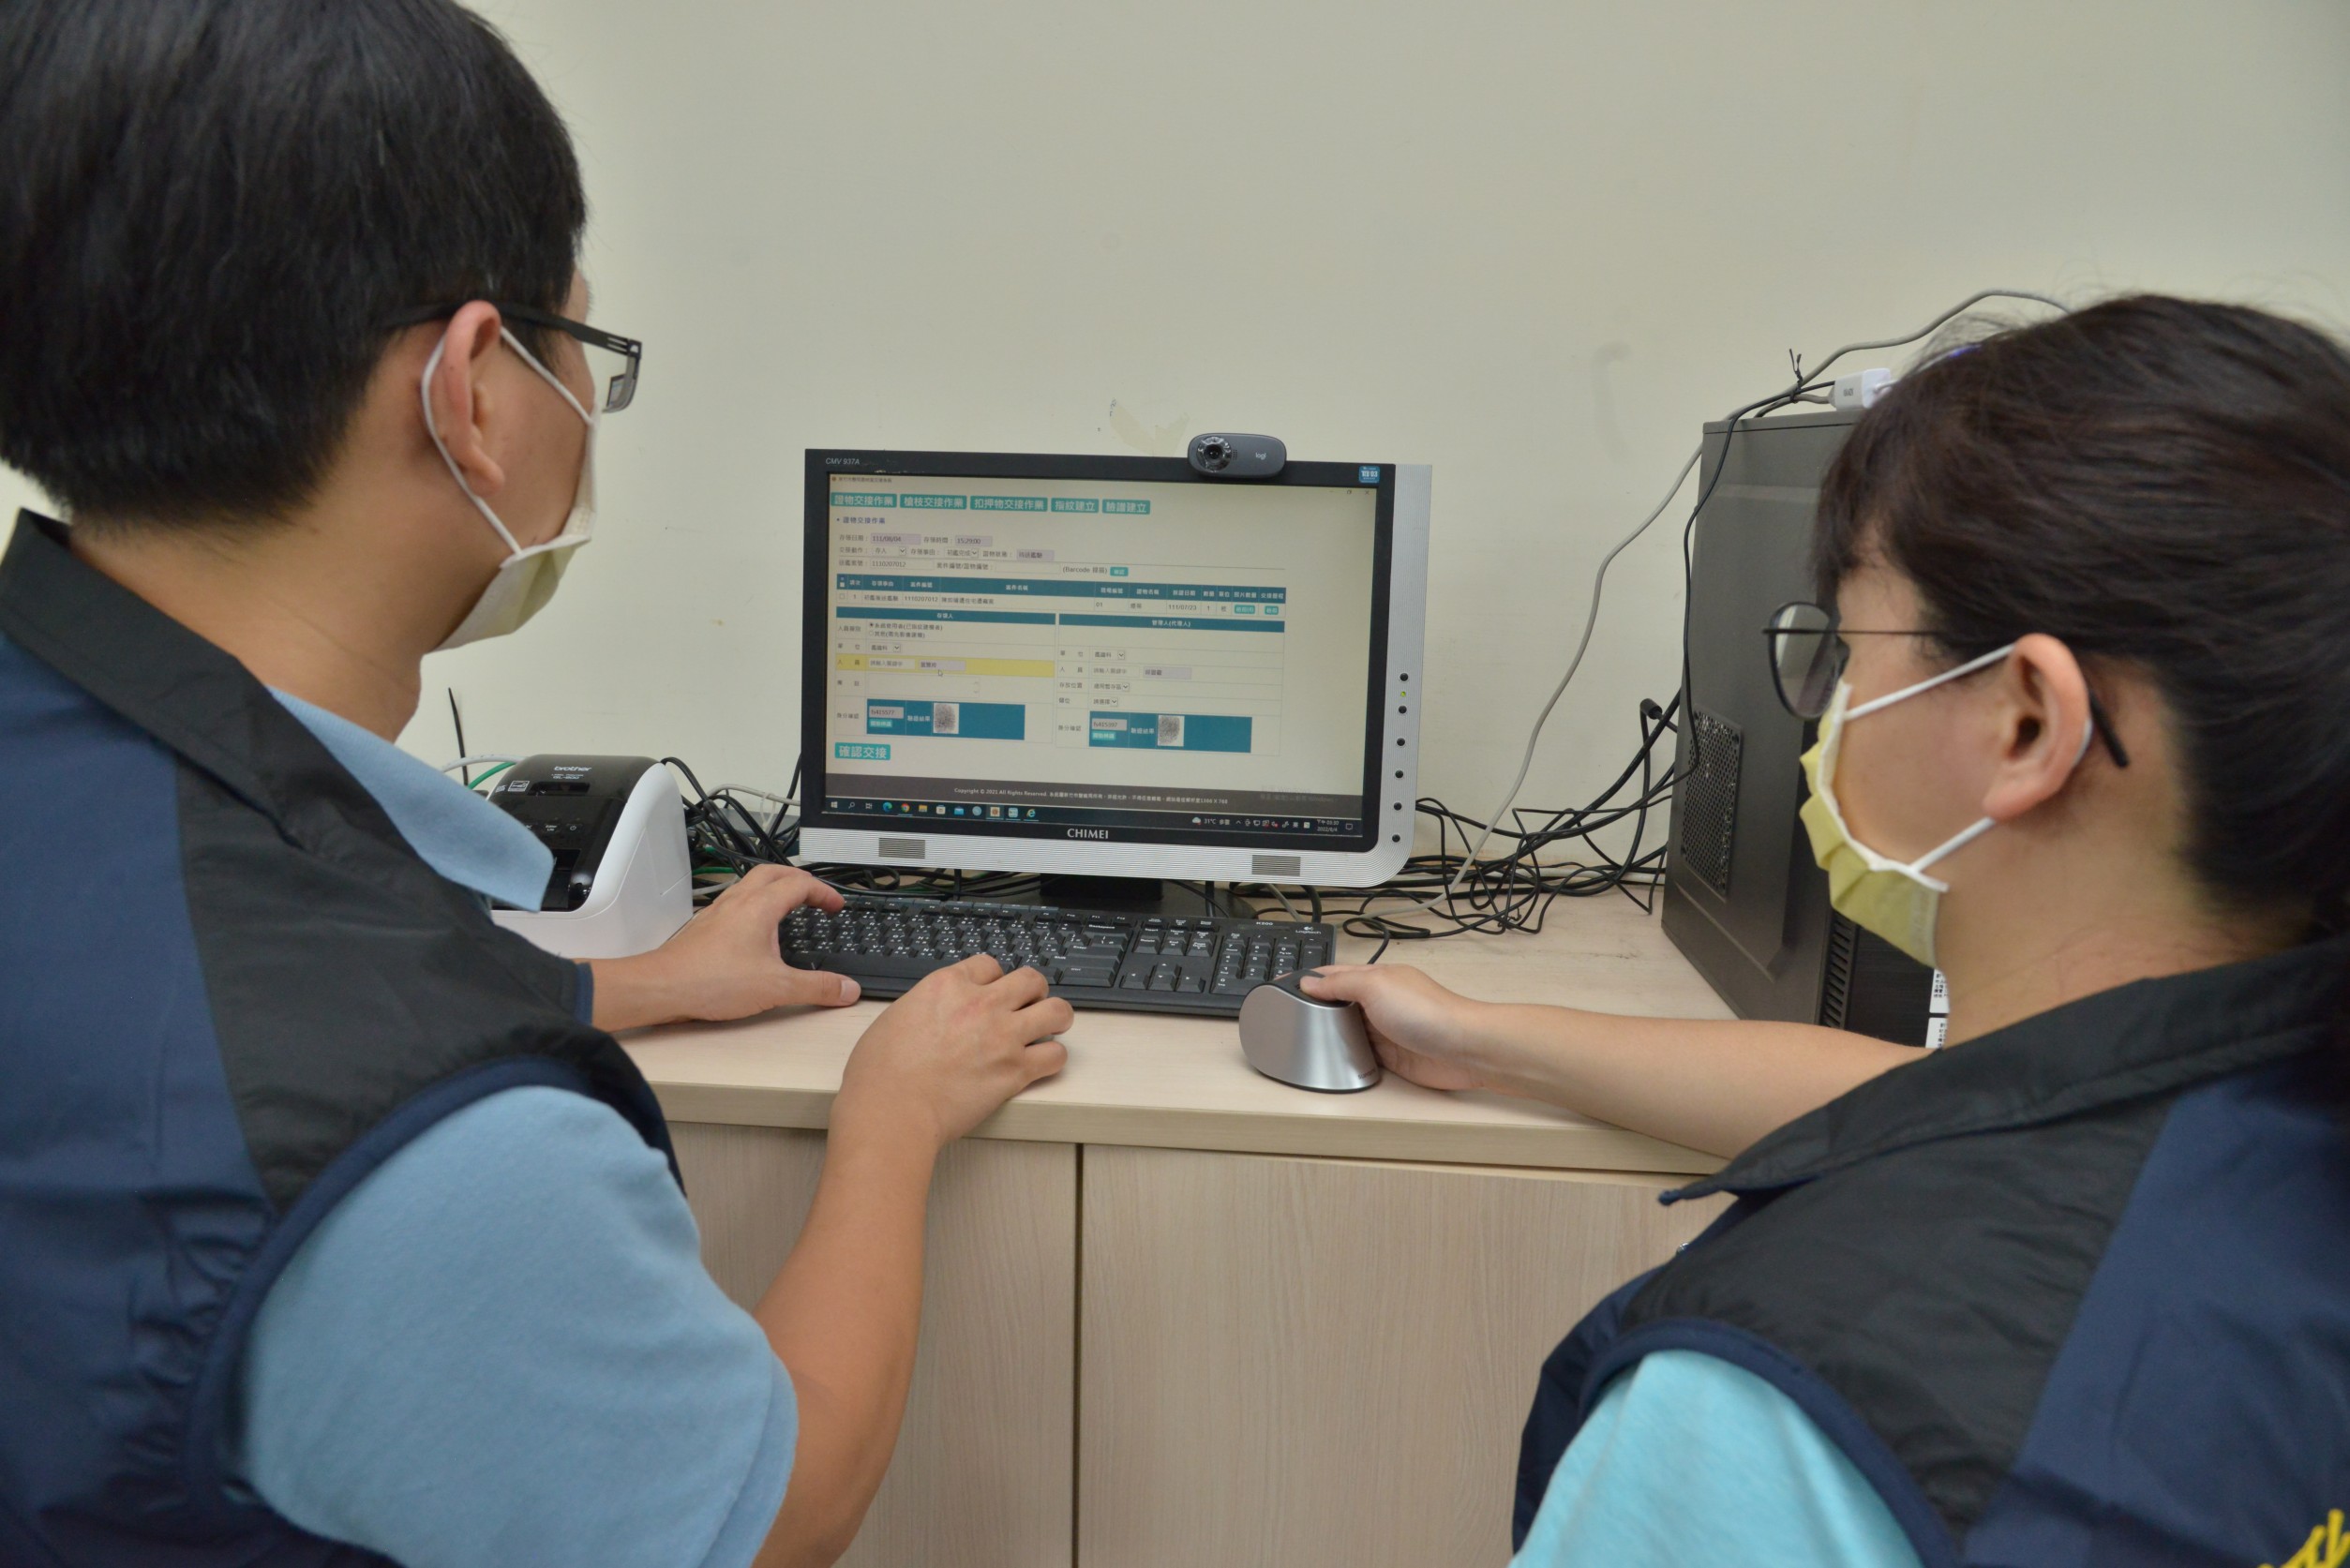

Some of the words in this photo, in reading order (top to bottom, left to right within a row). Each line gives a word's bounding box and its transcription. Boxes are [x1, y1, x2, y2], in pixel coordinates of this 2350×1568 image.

[834, 495, 893, 506] 證物交接作業
[904, 497, 963, 508] 槍枝交接作業
[975, 499, 1044, 510] 扣押物交接作業
[1055, 500, 1095, 512] 指紋建立
[839, 745, 887, 758] 確認交接
[954, 787, 979, 796] Copyright
[1067, 828, 1109, 840] CHIMEI
